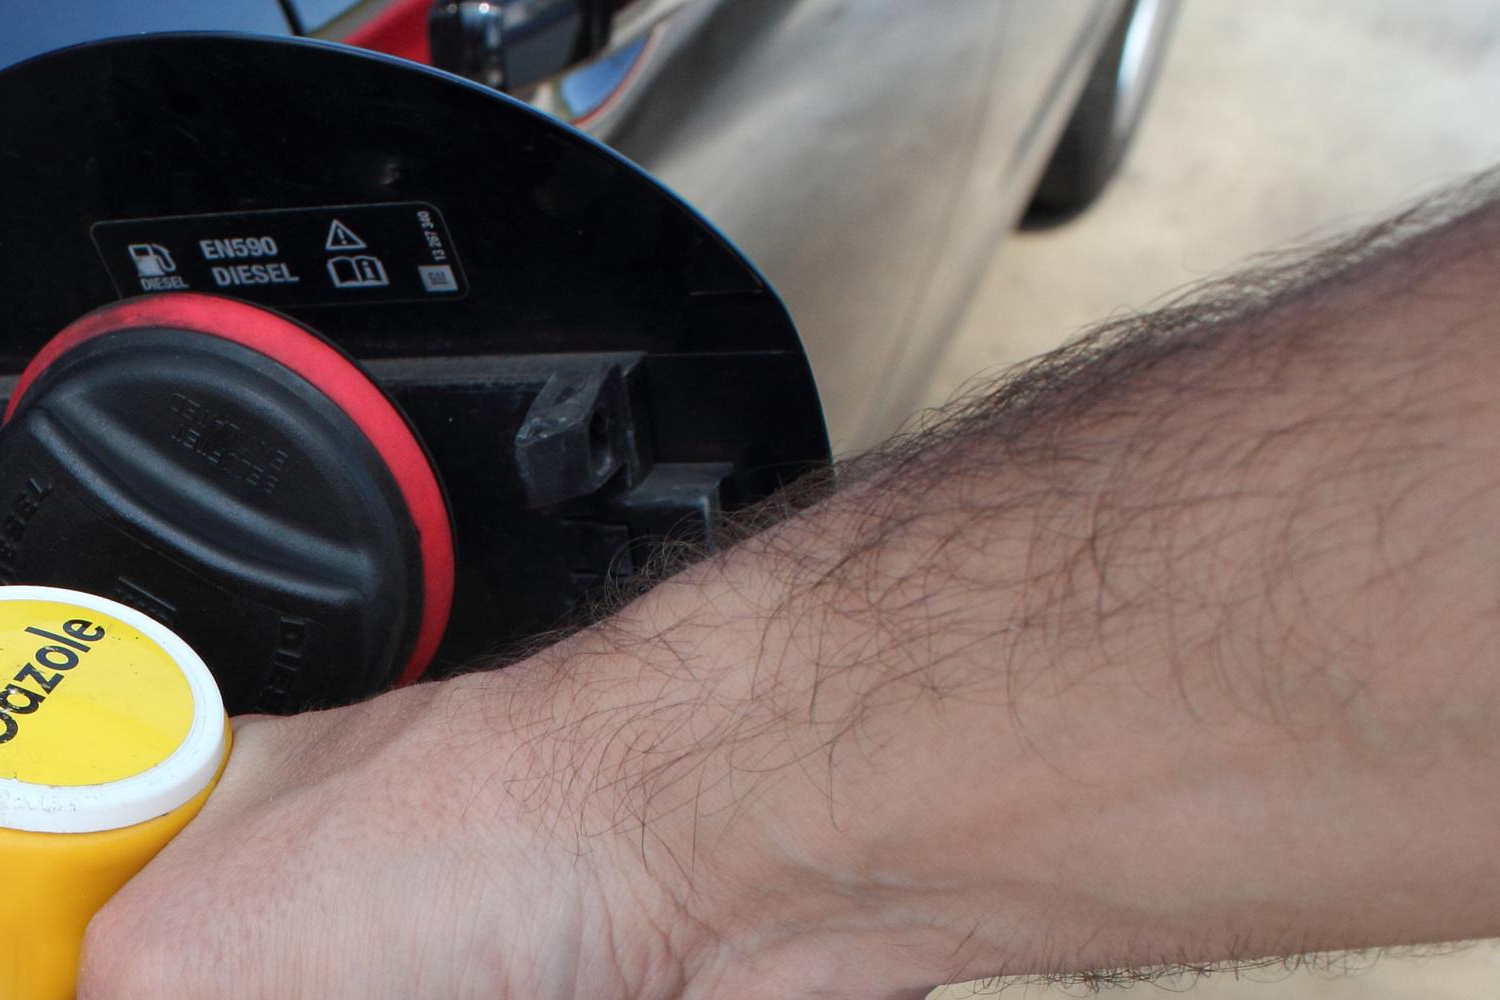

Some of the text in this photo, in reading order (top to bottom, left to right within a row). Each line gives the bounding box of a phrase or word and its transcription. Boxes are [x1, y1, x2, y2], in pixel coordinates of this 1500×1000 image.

[200, 236, 278, 260] EN590
[139, 275, 190, 291] DIESEL
[211, 262, 300, 287] DIESEL
